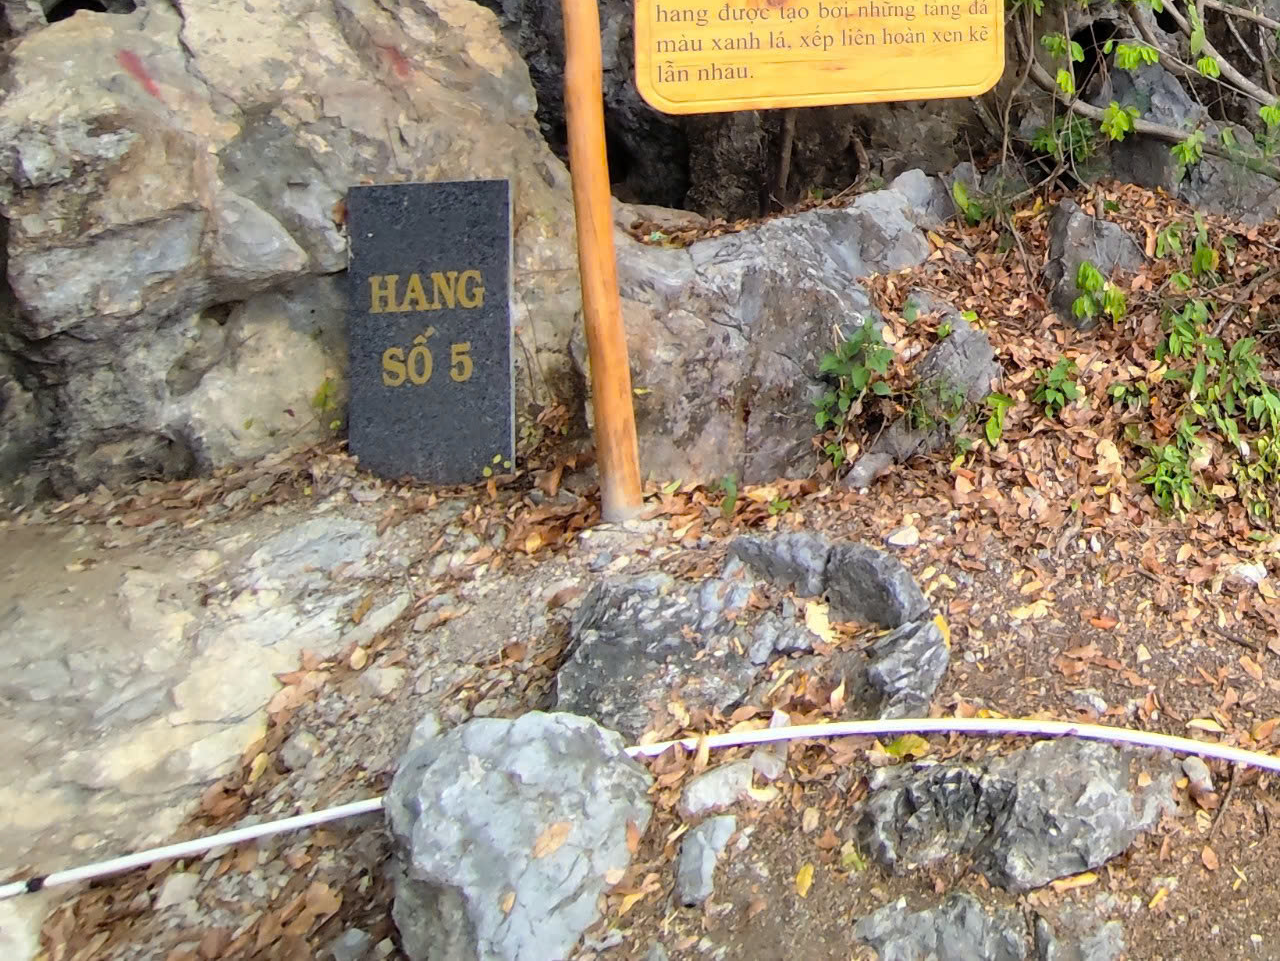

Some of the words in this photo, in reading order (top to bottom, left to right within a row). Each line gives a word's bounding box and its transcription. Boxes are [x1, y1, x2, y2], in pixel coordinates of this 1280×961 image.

[656, 4, 708, 26] hang
[718, 3, 770, 24] được
[780, 5, 809, 23] tạo
[858, 1, 916, 21] những
[656, 34, 703, 53] màu
[711, 32, 761, 50] xanh
[769, 31, 792, 50] lá,
[799, 25, 834, 51] xếp
[841, 28, 875, 46] liên
[882, 27, 926, 45] hoàn
[932, 31, 963, 43] xen
[969, 25, 989, 42] kẽ
[657, 60, 689, 83] lẫn
[368, 269, 486, 314] HANG
[381, 325, 437, 387] SỐ
[449, 341, 474, 383] 5
